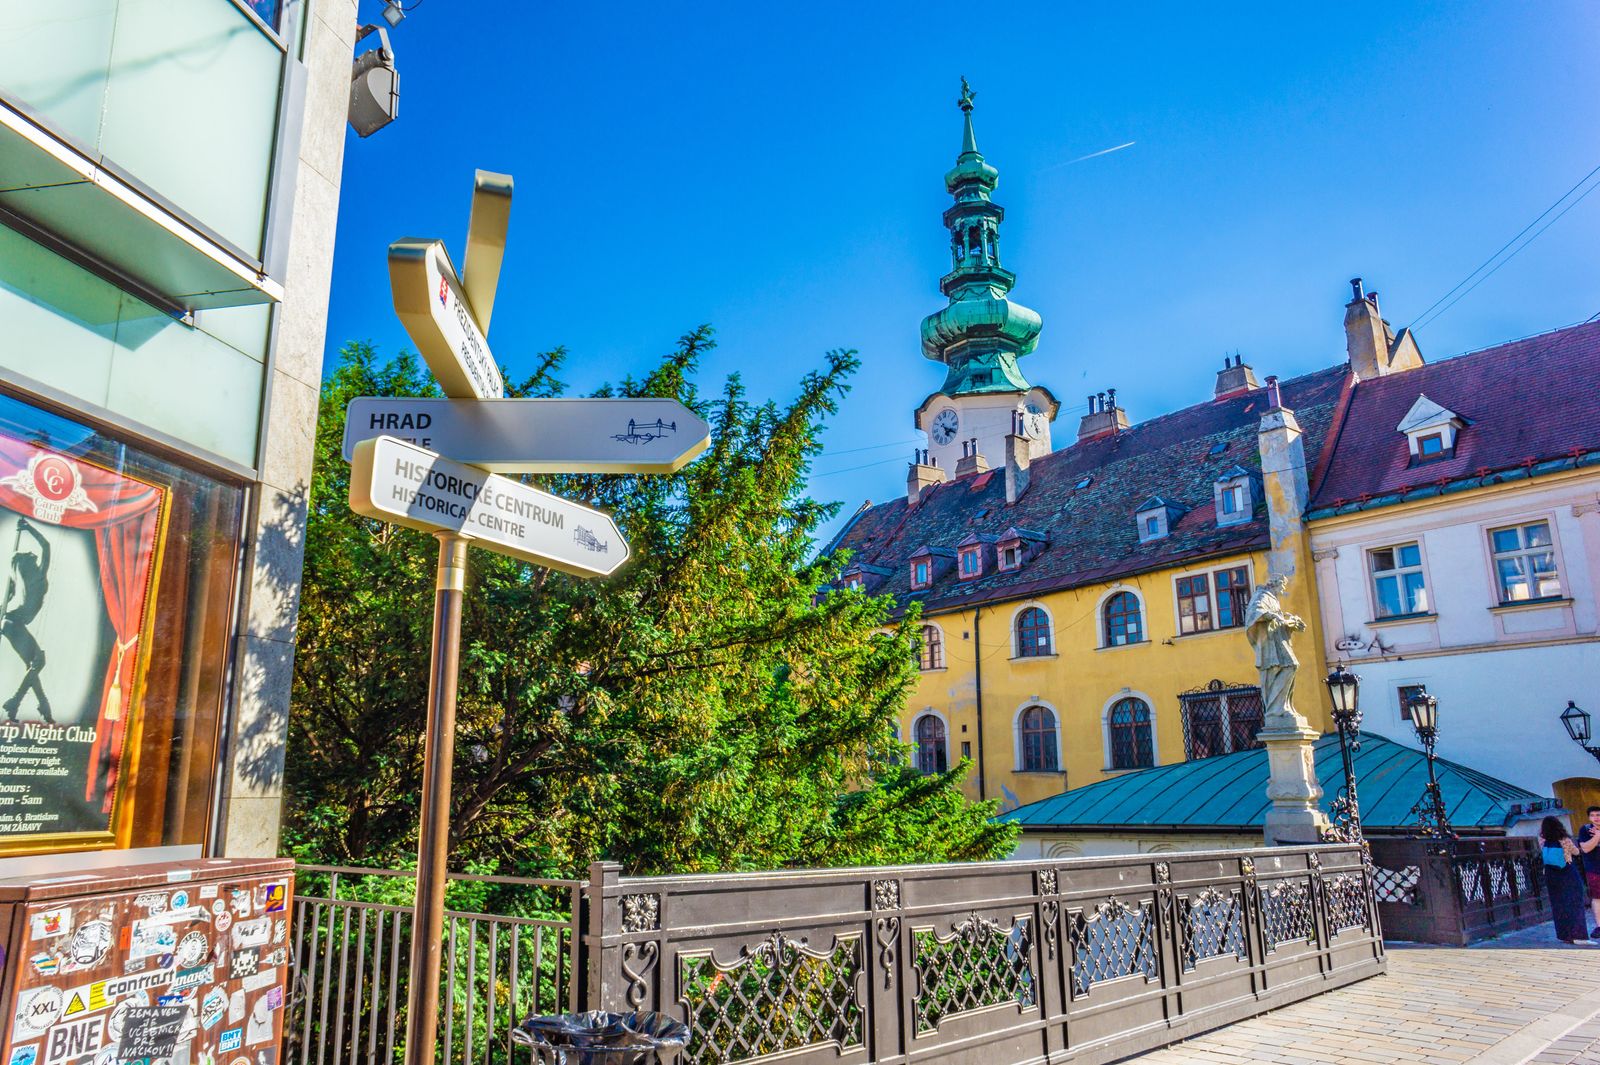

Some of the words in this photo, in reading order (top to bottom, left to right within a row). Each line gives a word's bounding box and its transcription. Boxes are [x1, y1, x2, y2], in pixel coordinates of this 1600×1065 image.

[369, 413, 432, 430] HRAD
[395, 458, 493, 506] HISTORICKÉ
[495, 493, 564, 530] CENTRUM
[392, 485, 475, 523] HISTORICAL
[478, 512, 526, 538] CENTRE
[21, 723, 64, 745] Night
[66, 726, 97, 743] Club
[28, 745, 58, 755] dancers
[0, 755, 18, 764] how
[19, 757, 41, 767] every
[40, 757, 61, 767] night
[12, 766, 36, 776] dance
[36, 767, 69, 776] available
[20, 794, 43, 805] 5am
[24, 812, 59, 821] Bratislava
[11, 821, 43, 832] ZÁBAVY
[107, 969, 175, 996] contrast
[31, 1000, 57, 1017] XXL
[49, 1019, 102, 1062] BNE
